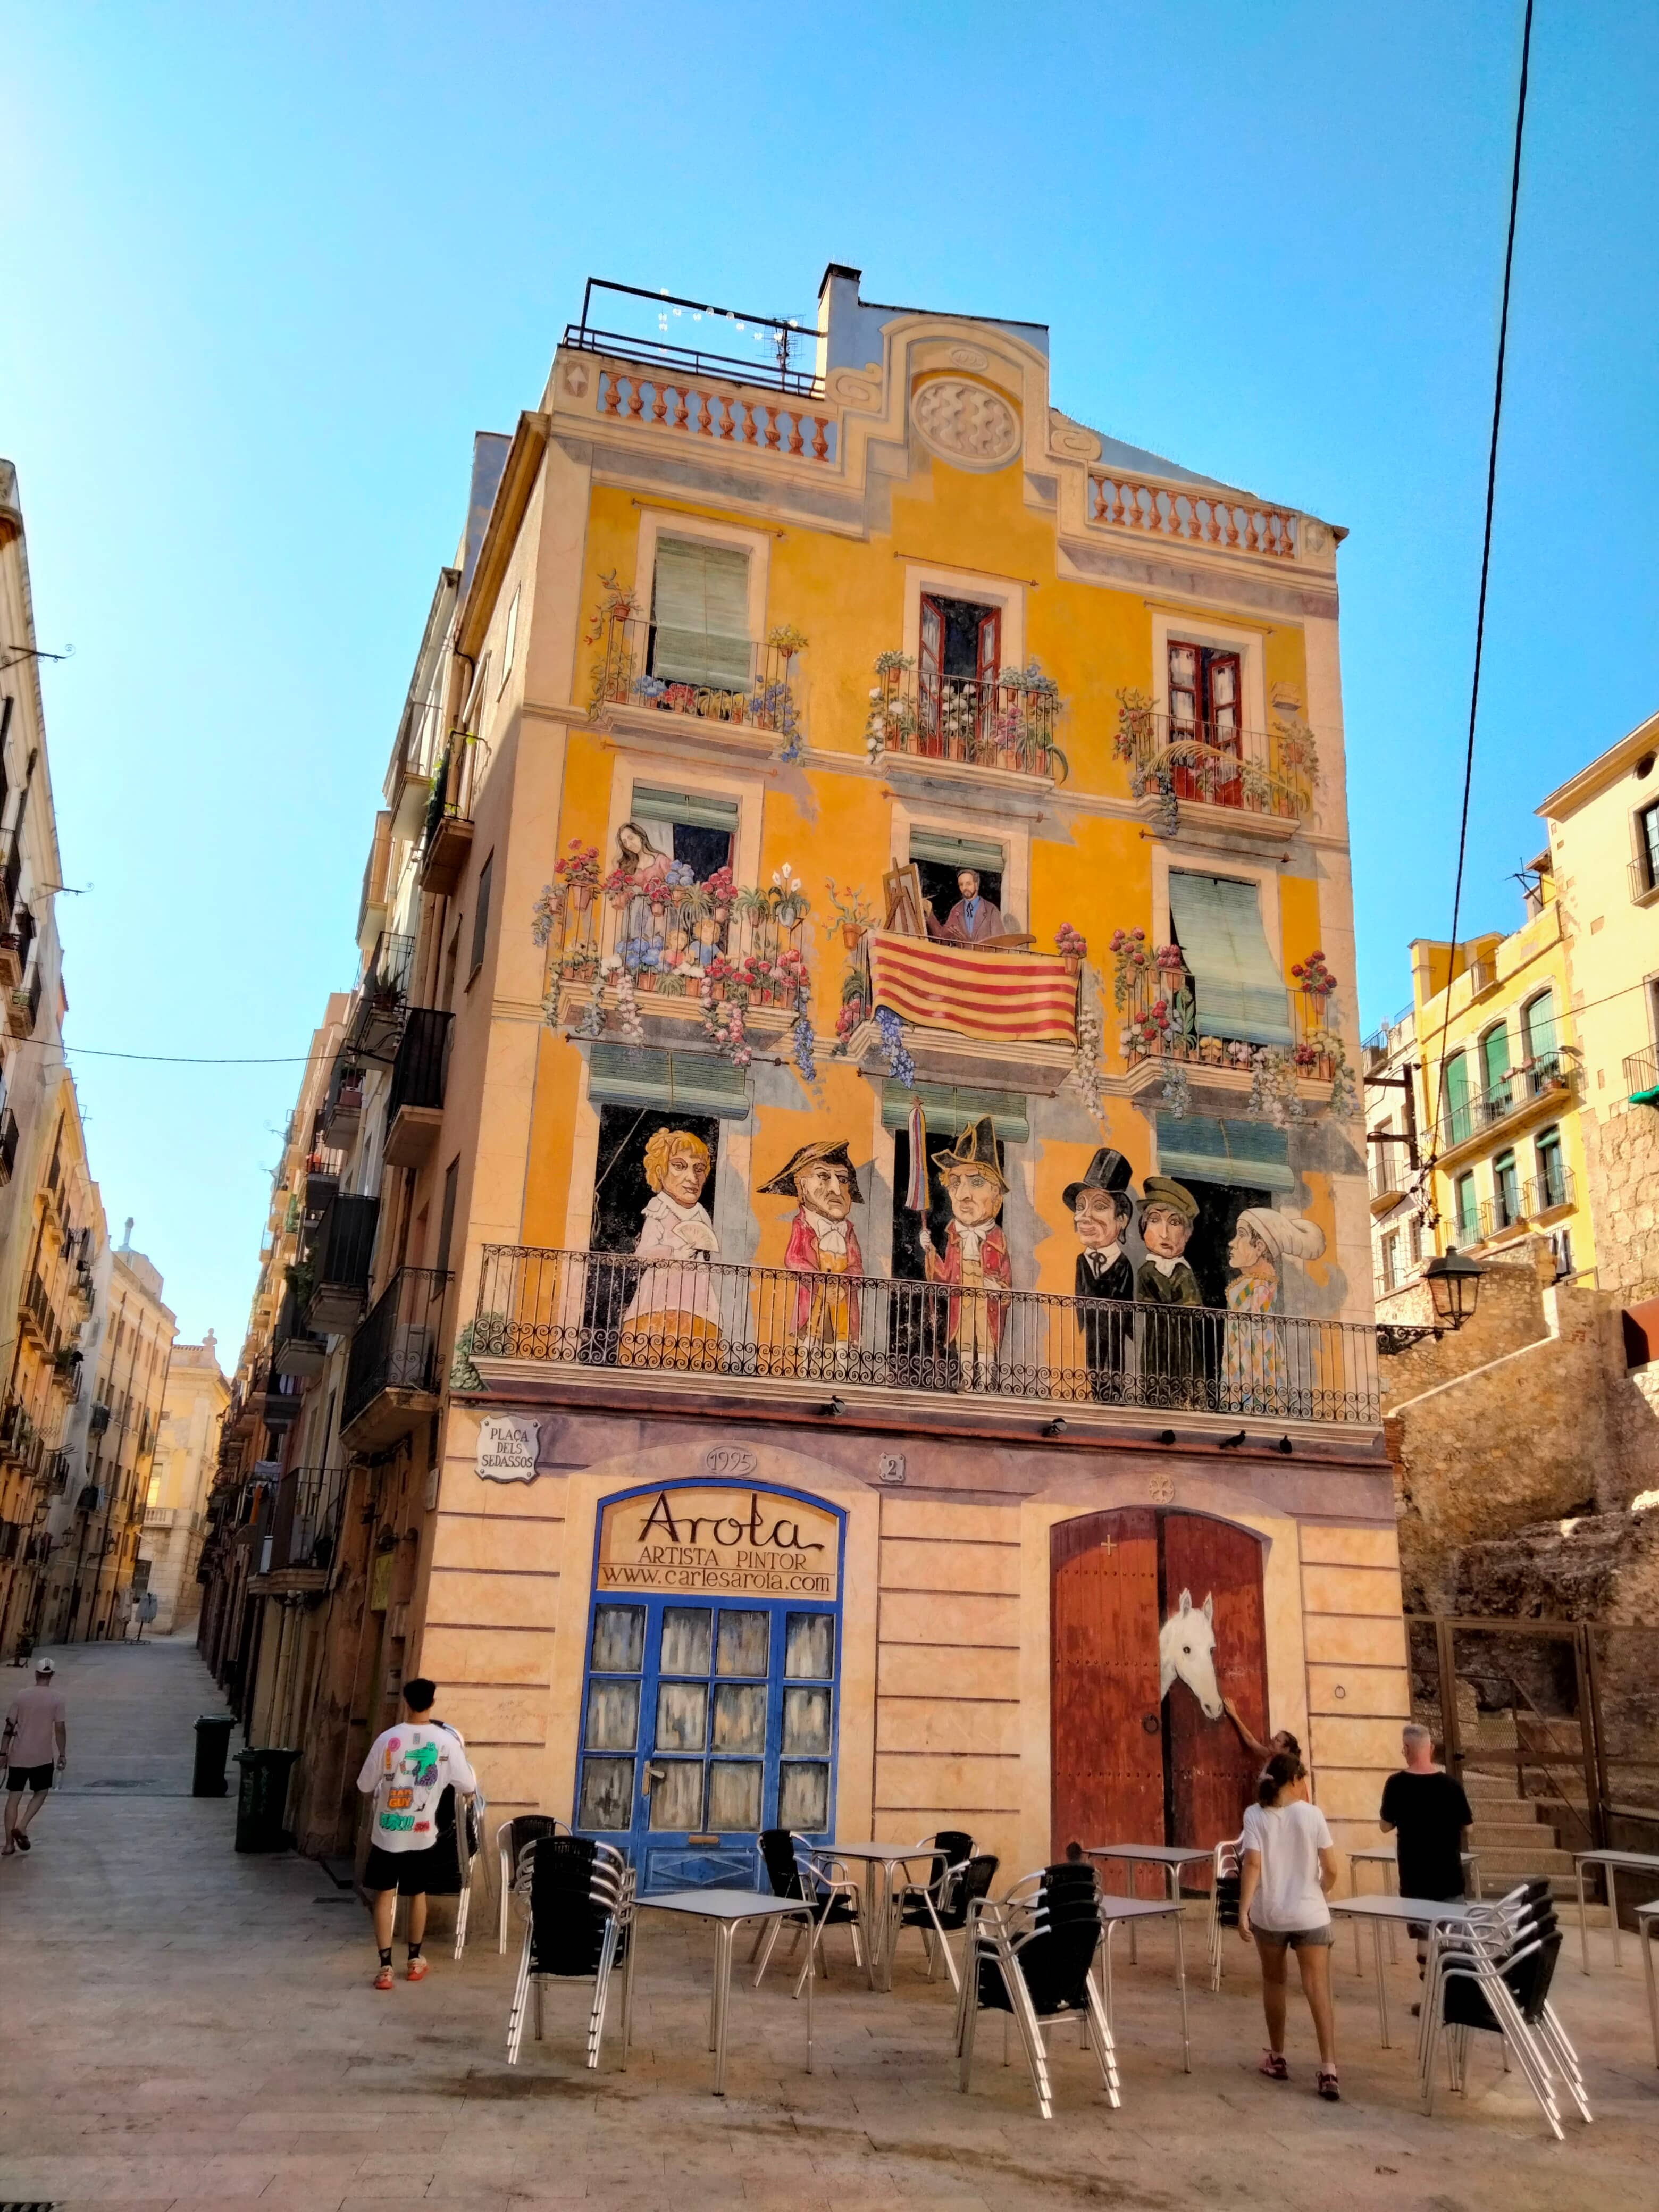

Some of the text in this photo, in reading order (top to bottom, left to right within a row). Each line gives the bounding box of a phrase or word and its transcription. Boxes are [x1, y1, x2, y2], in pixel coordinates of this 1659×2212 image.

[490, 1428, 528, 1442] PLAÇA
[497, 1442, 522, 1454] DELS
[482, 1455, 533, 1468] SEDASSOS
[710, 1452, 753, 1472] 1995
[889, 1460, 896, 1475] 2
[638, 1490, 825, 1551] Arola
[638, 1546, 808, 1570] ARTISTA PINTOR
[602, 1567, 830, 1591] www.carlesarola.com
[389, 1797, 413, 1808] GUY
